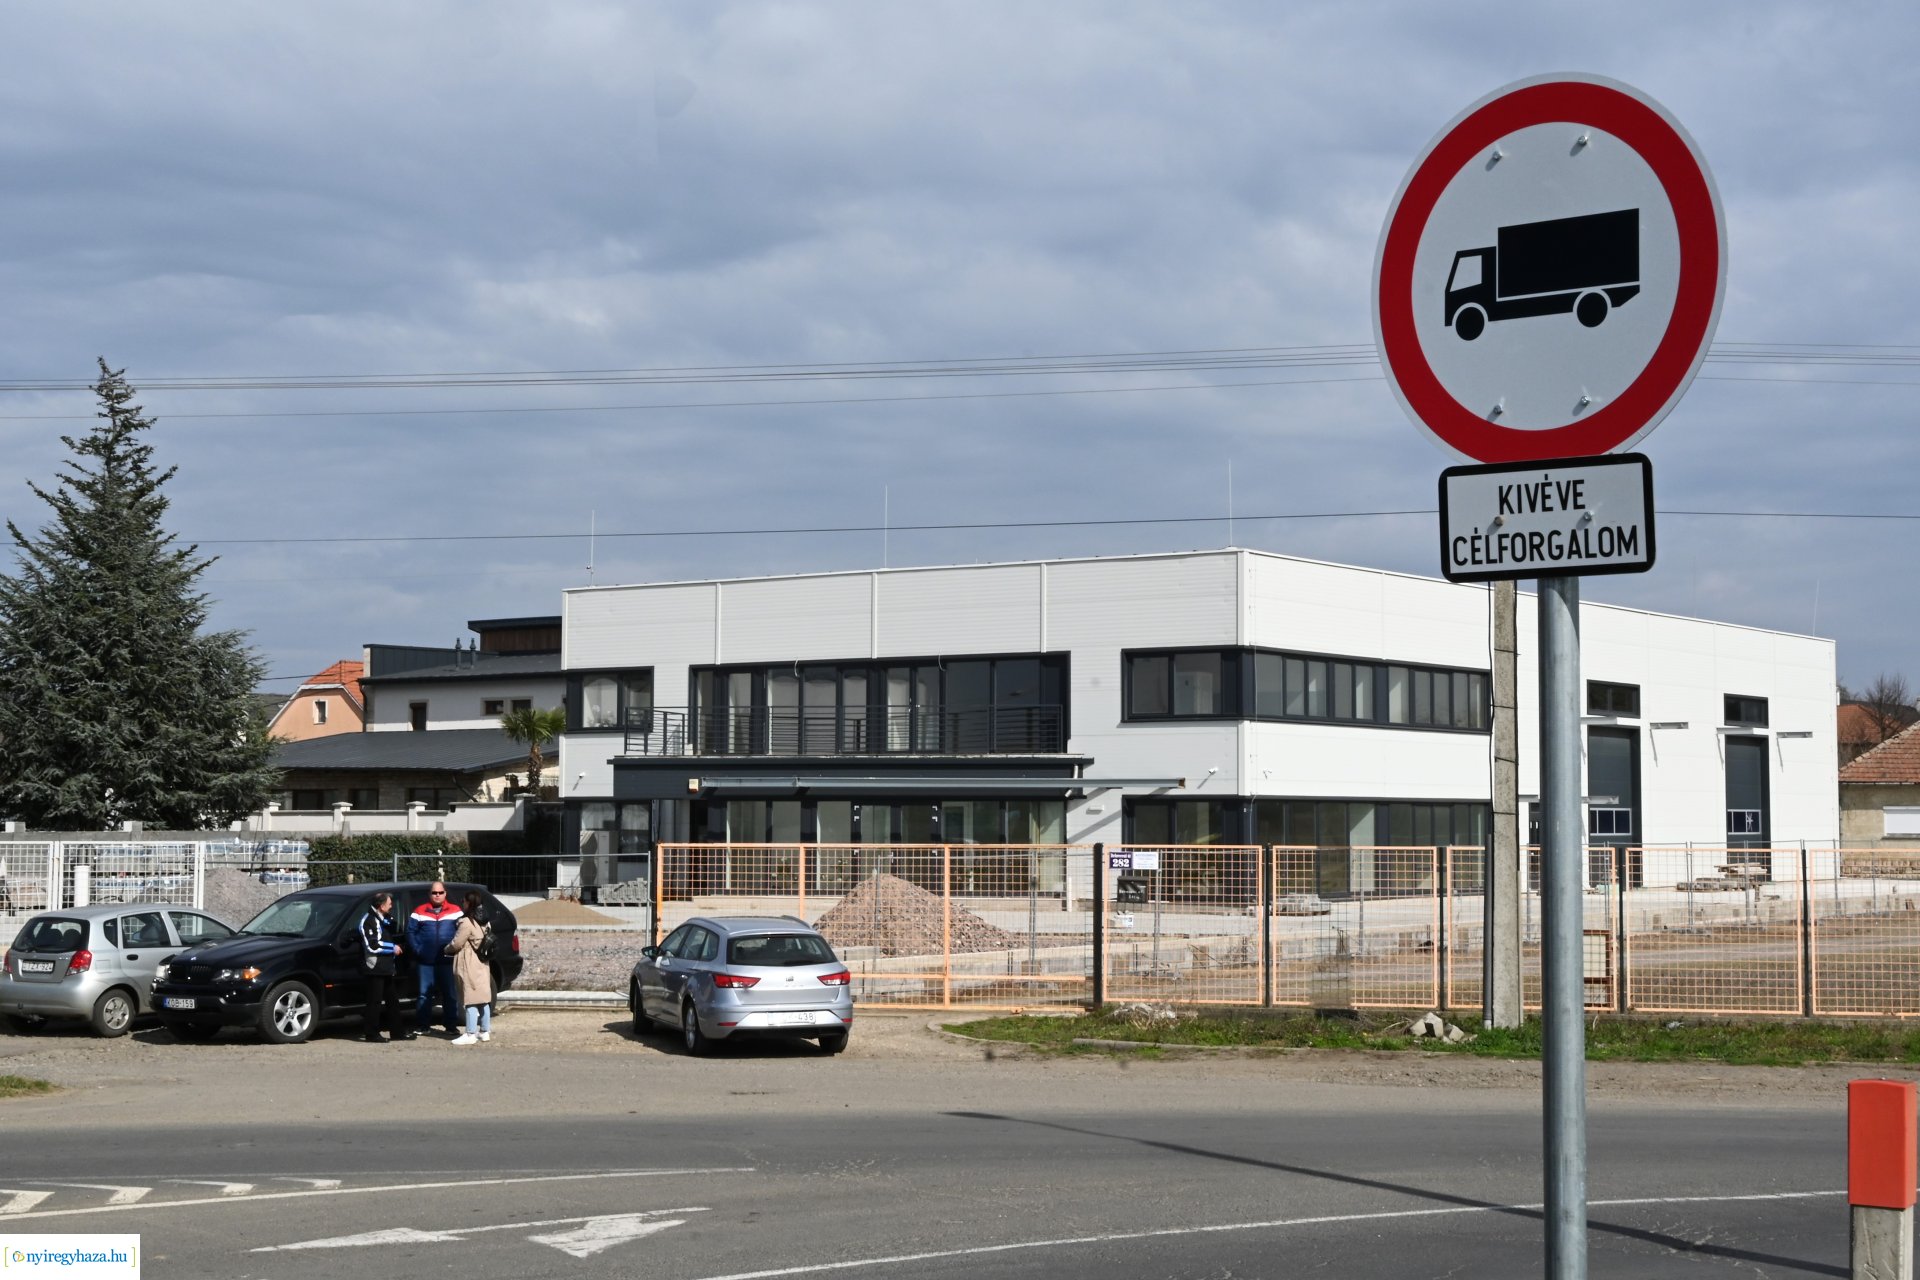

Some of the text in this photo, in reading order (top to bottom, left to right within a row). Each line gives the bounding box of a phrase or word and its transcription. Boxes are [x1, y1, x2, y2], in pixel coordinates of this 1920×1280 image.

[1498, 474, 1586, 515] KIVÉVE
[1453, 525, 1638, 567] CÉLFORGALOM
[1112, 858, 1130, 868] 282
